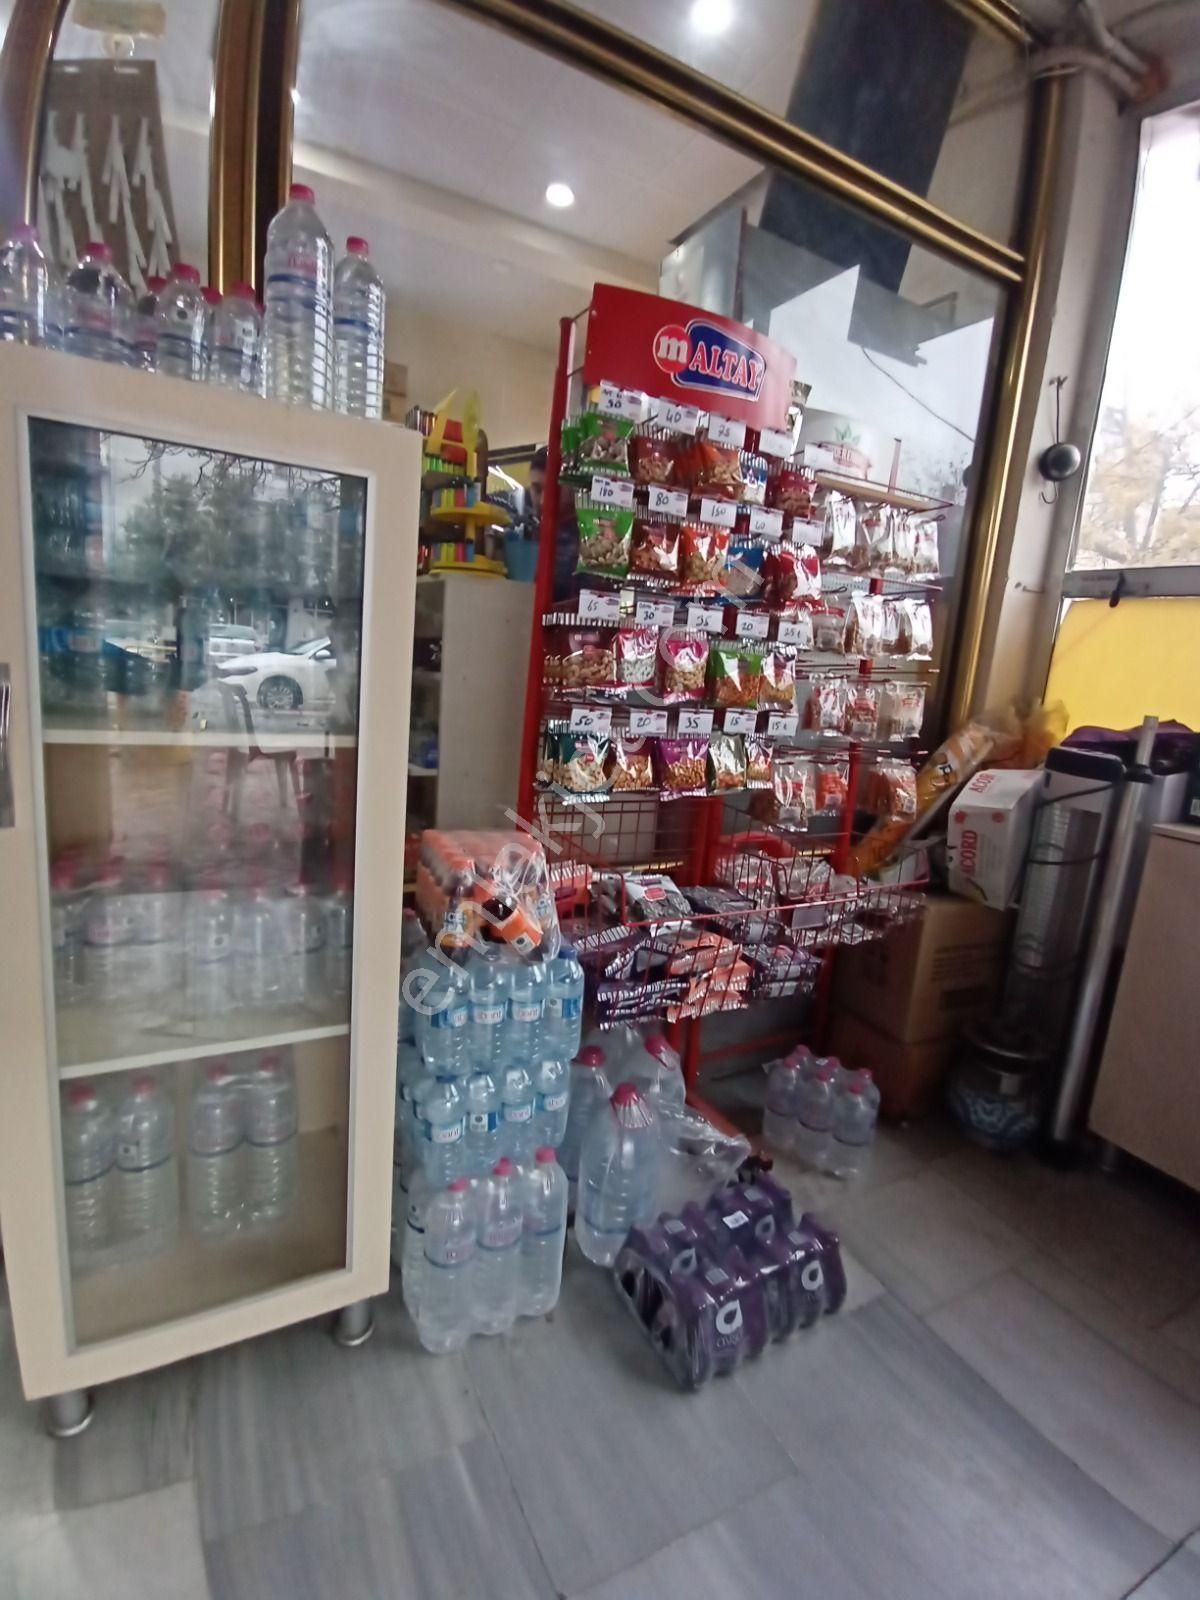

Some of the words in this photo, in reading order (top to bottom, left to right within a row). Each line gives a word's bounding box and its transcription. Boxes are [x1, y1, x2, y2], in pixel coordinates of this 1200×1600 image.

[666, 410, 682, 422] 40
[656, 492, 670, 506] 80
[643, 610, 655, 621] 30
[575, 716, 594, 727] 50
[685, 717, 701, 729] 35
[730, 716, 742, 726] 15
